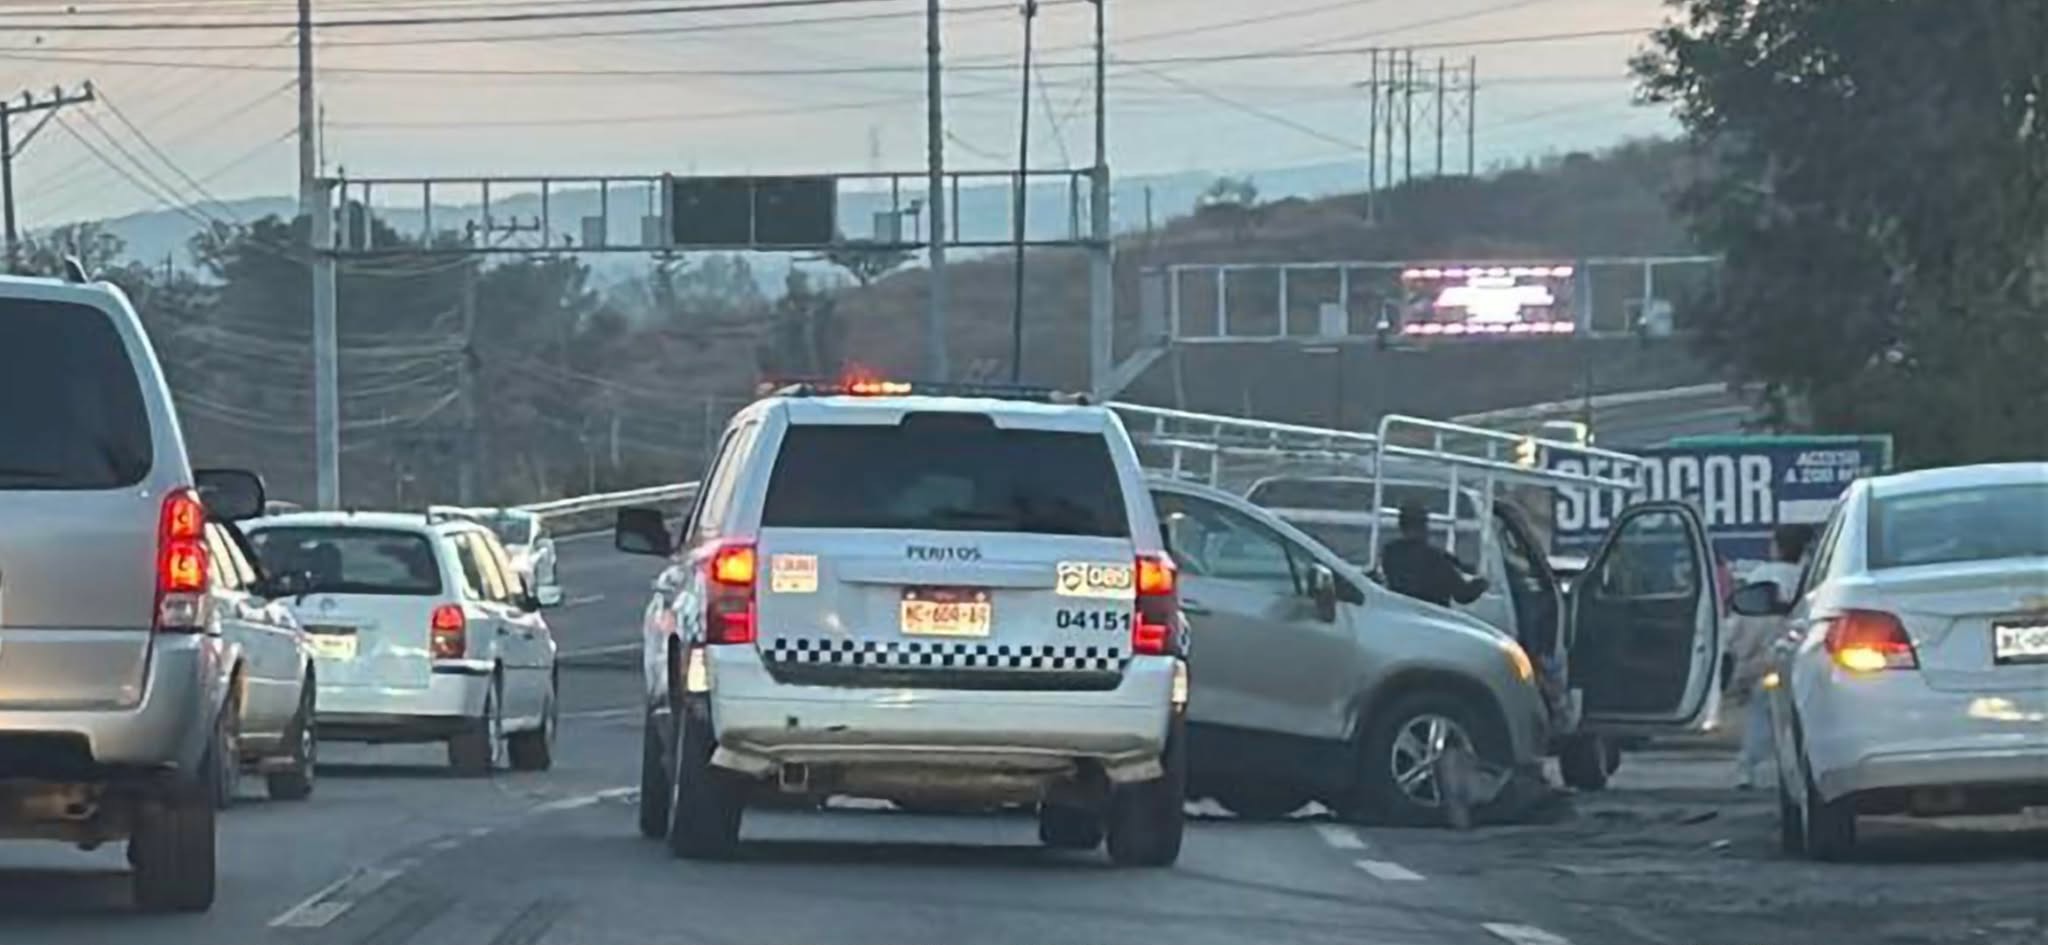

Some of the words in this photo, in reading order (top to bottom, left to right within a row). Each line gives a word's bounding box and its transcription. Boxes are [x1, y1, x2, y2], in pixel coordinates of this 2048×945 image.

[1783, 467, 1797, 483] A
[906, 545, 983, 562] PERITOS
[1056, 608, 1131, 631] 04151
